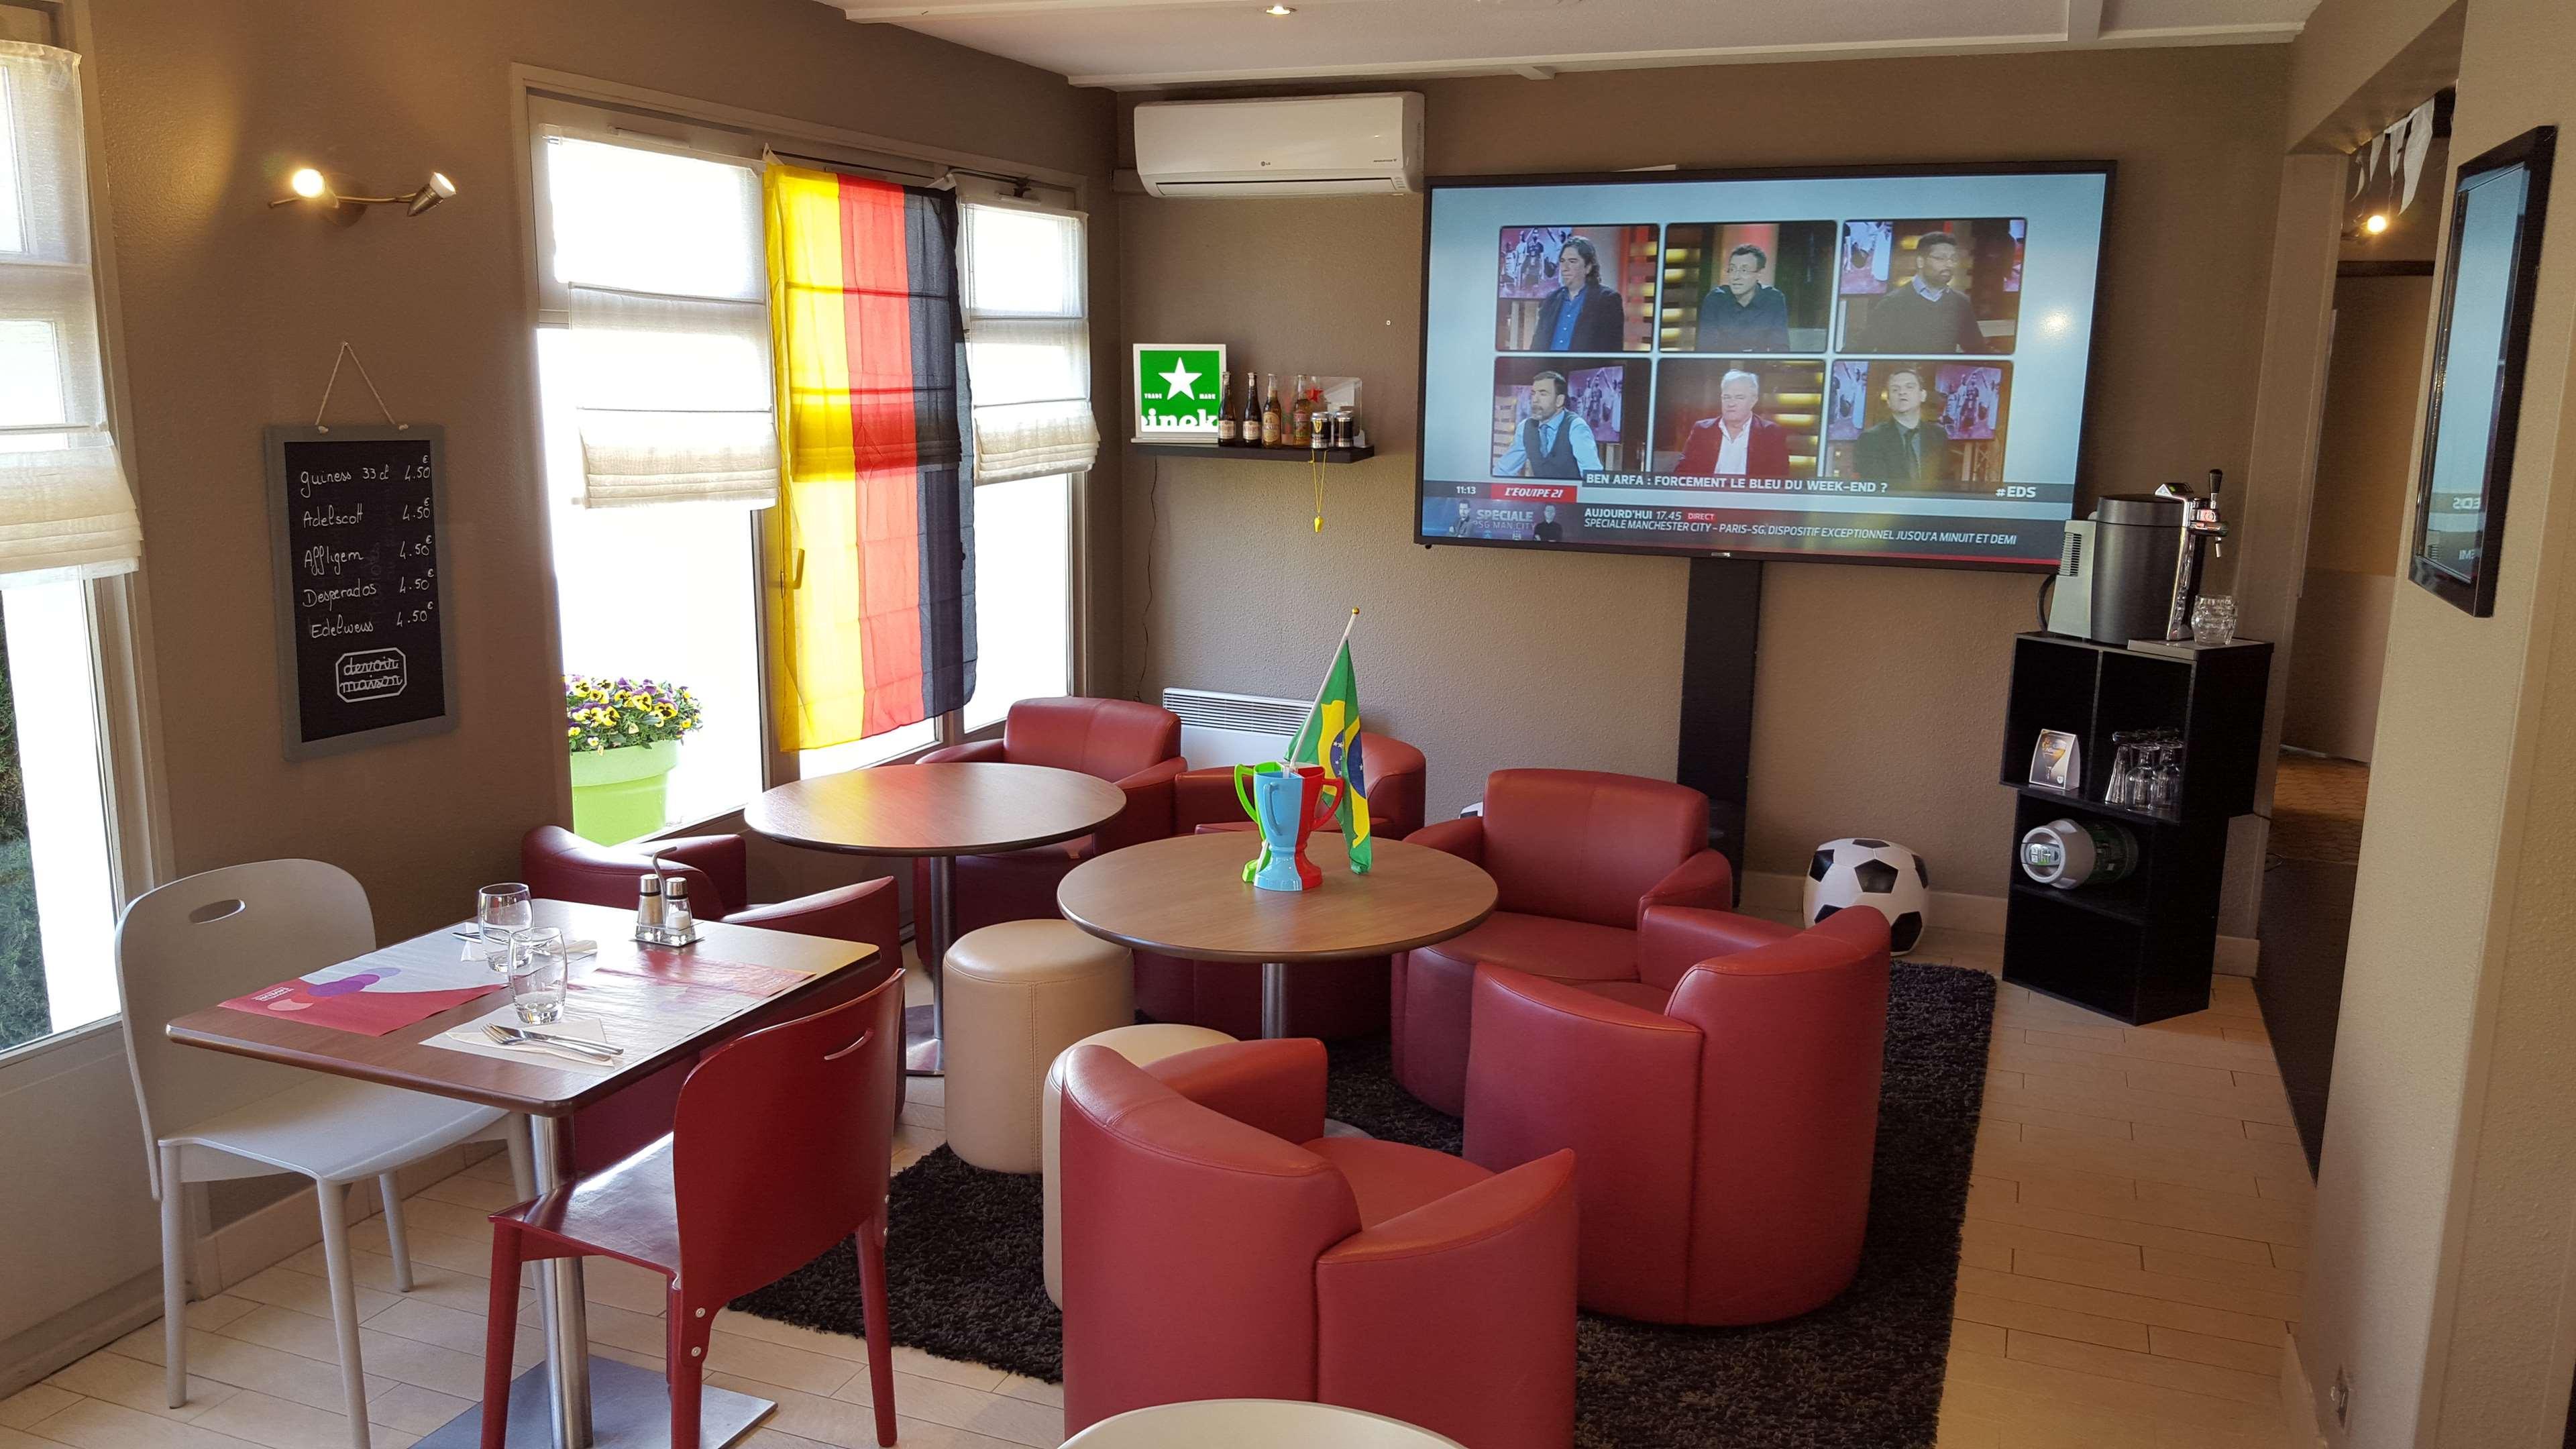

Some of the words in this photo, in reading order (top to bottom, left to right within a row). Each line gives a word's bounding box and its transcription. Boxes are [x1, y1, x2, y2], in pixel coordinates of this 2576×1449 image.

[362, 467, 376, 479] 33
[1456, 486, 1476, 494] 11:13
[1586, 474, 1610, 484] BEN
[1613, 474, 1644, 486] ARFA
[1654, 475, 1727, 488] FORCEMENT
[1731, 478, 1746, 488] LE
[1750, 478, 1780, 490] BLEU
[1784, 480, 1803, 490] DU
[1807, 480, 1876, 492] WEEK-END
[1880, 482, 1888, 492] ?
[1996, 486, 2036, 498] #EDS
[1505, 487, 1552, 497] L'EQUIPE
[1551, 489, 1564, 498] 21
[303, 503, 364, 529] Adelscott
[1477, 509, 1534, 521] SPECIALE
[1585, 508, 1653, 519] AUJOURD'HUI
[1656, 511, 1682, 521] 17.45
[1516, 522, 1536, 531] CITY
[1584, 518, 1627, 529] SPECIALE
[1627, 520, 1688, 531] MANCHESTER
[1690, 522, 1711, 532] CITY
[1768, 525, 1821, 537] DISPOSITIF
[1821, 527, 1894, 540] EXCEPTIONNEL
[1939, 532, 1975, 543] MINUIT
[1976, 533, 1990, 543] ET
[1990, 534, 2017, 545] DEMI
[305, 545, 364, 576] Affligem
[303, 578, 377, 611] Desperados
[311, 614, 374, 638] Edelweiss
[343, 657, 400, 676] devoir
[339, 674, 403, 694] maison
